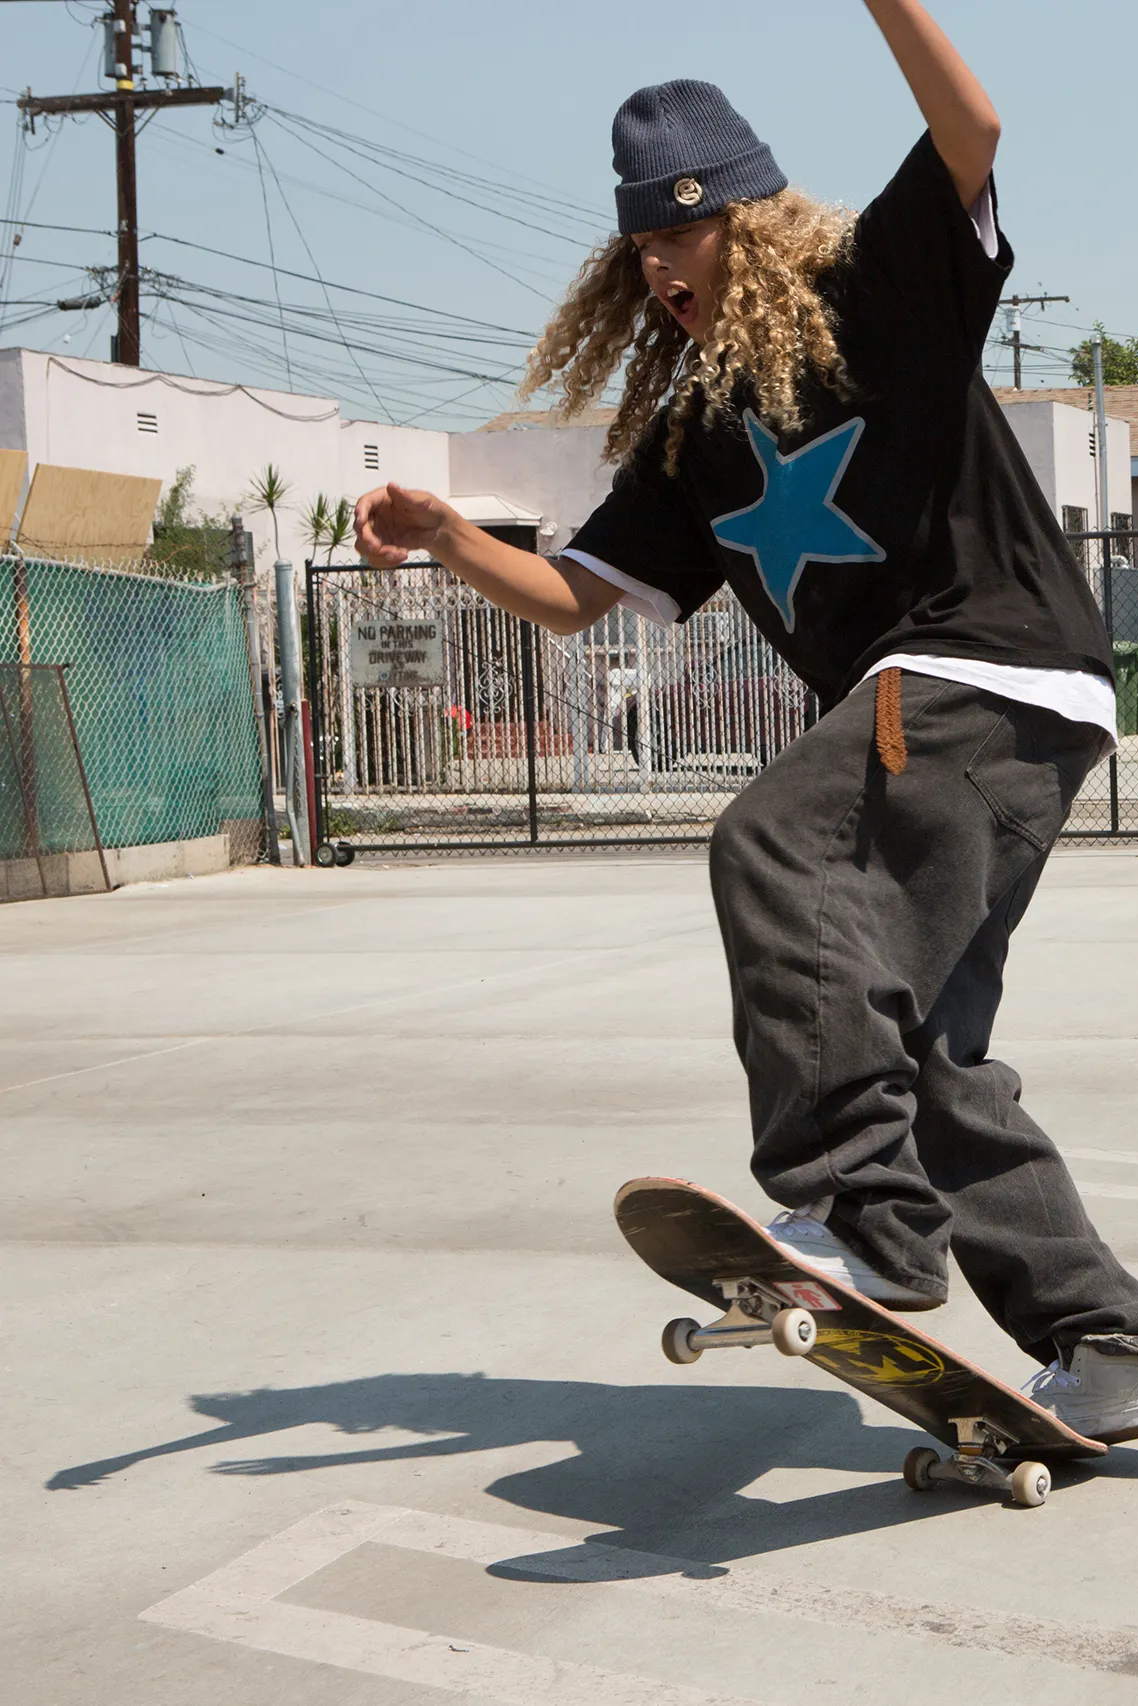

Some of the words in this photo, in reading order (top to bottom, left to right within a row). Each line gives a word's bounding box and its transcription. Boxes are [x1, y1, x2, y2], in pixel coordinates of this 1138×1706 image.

[358, 626, 376, 641] NO
[380, 624, 436, 640] PARKING
[381, 640, 390, 648] IN
[393, 640, 413, 648] THIS
